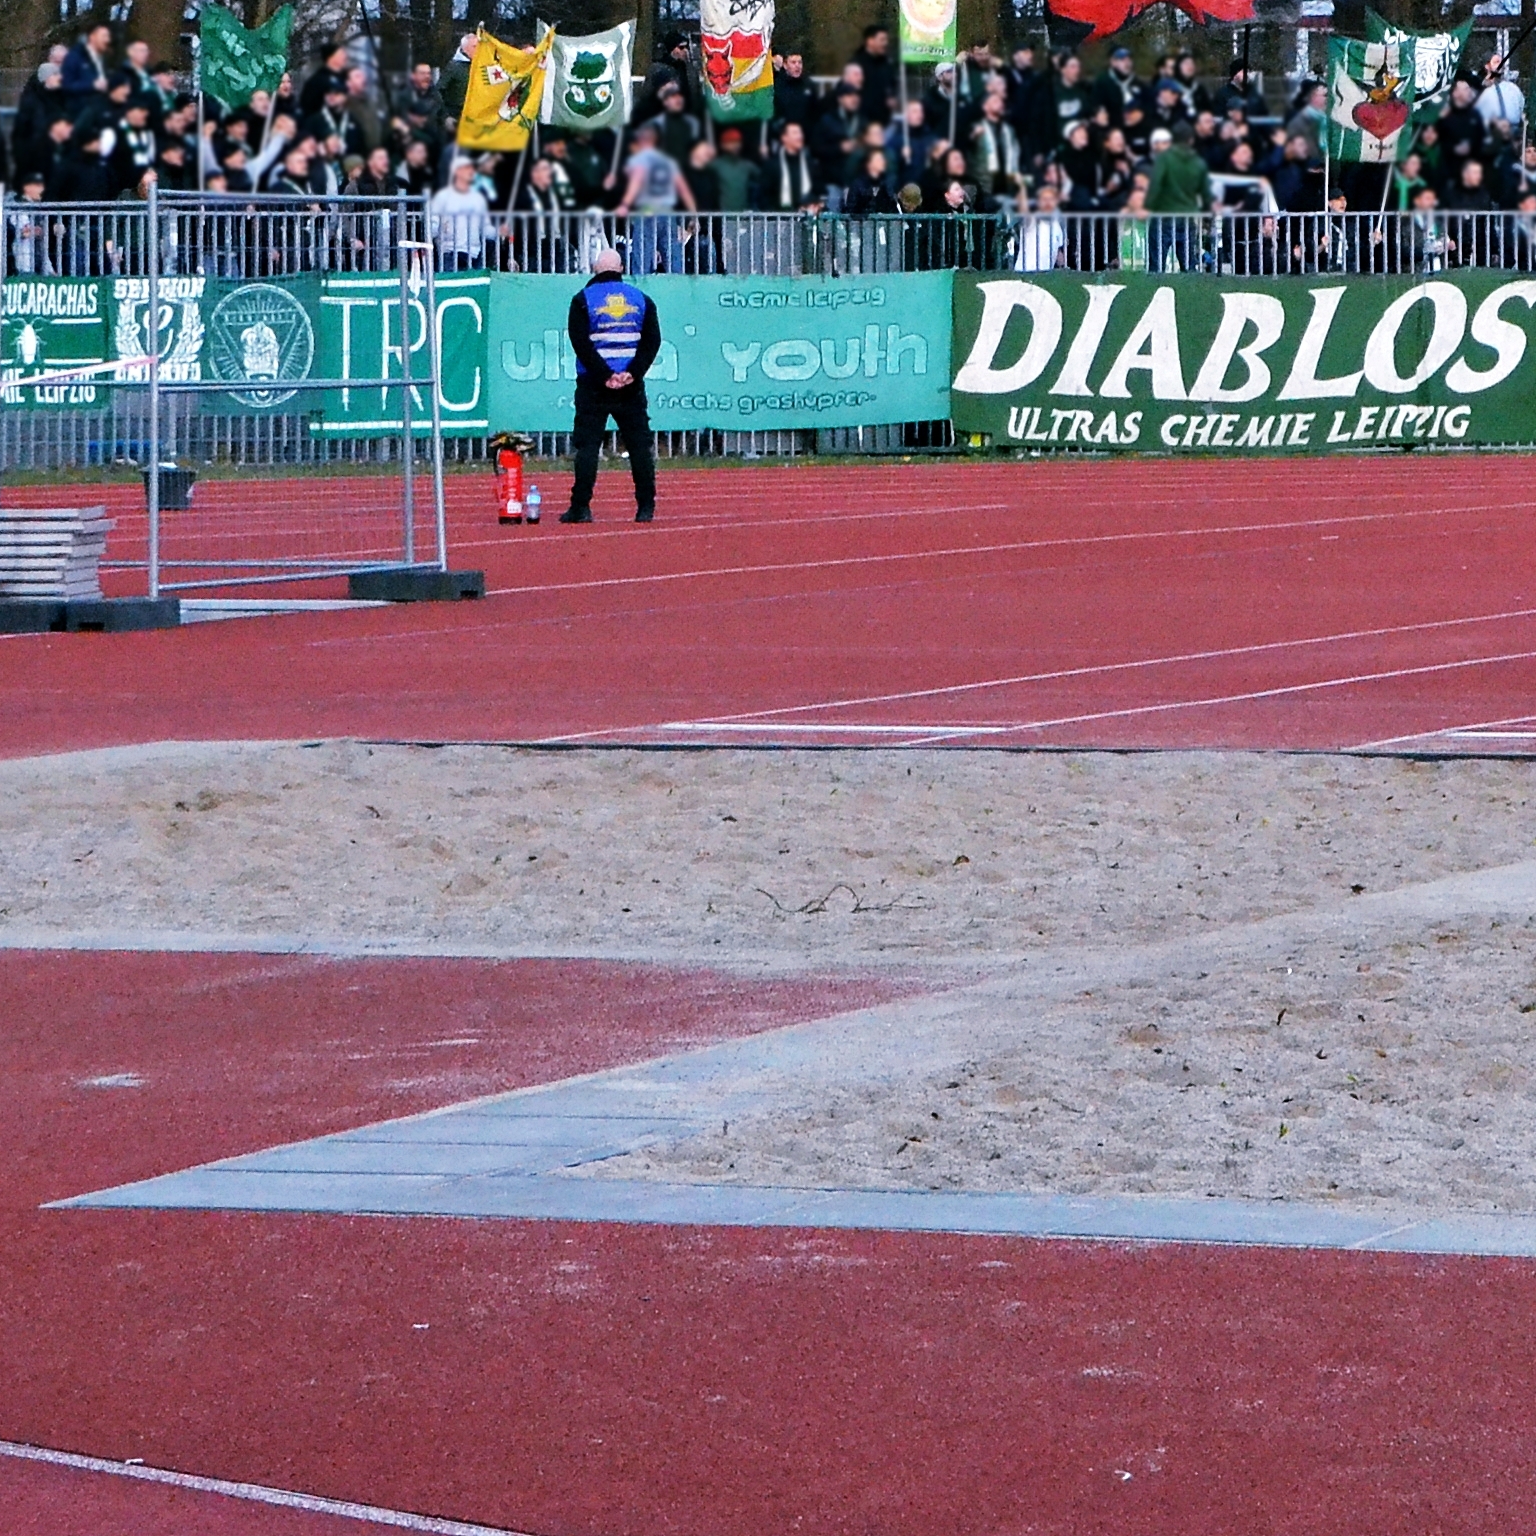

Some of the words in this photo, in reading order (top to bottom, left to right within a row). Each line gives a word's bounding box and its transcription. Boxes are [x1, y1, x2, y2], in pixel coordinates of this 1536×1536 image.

[318, 295, 483, 413] TRC
[1007, 406, 1142, 443] ULTRAS
[1161, 412, 1311, 448] CHEMIE
[1327, 404, 1472, 443] LEIPZIG
